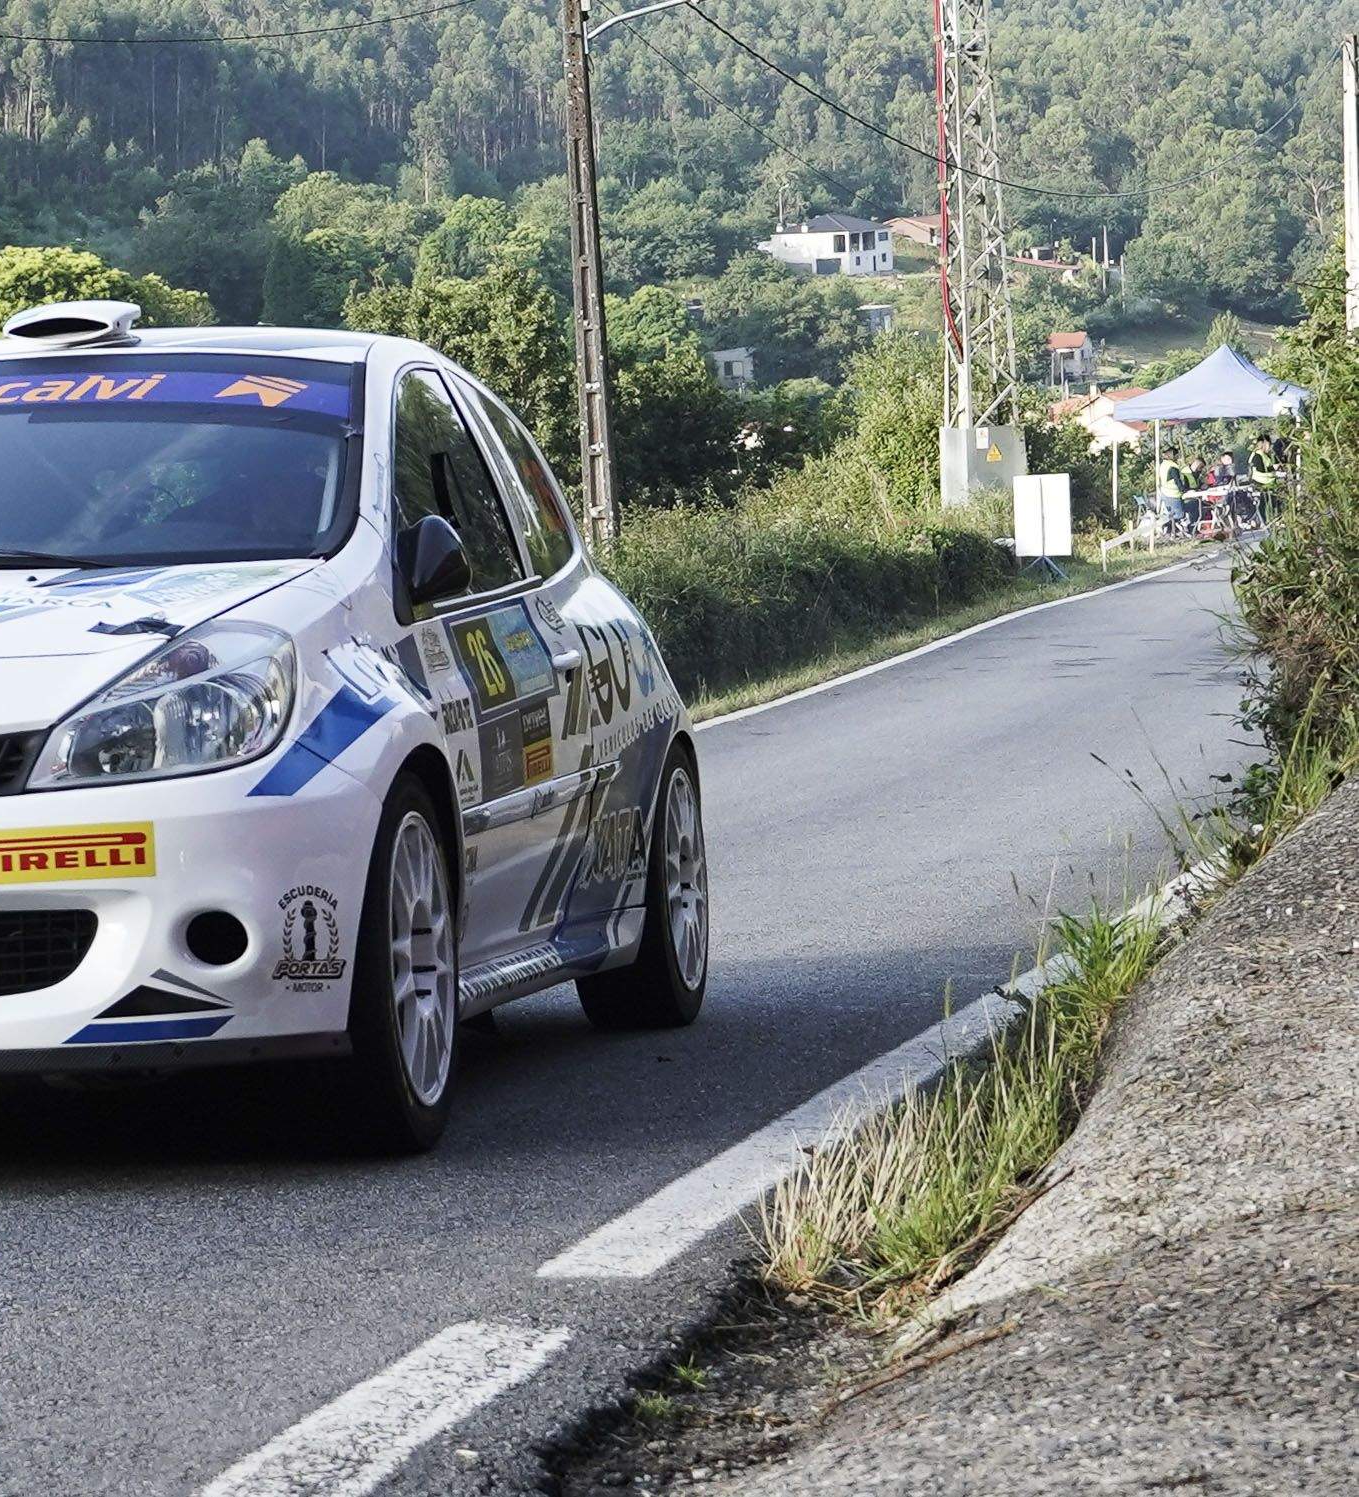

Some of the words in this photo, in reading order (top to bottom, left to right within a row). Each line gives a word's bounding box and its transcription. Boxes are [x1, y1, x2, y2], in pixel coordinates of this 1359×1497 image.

[466, 628, 506, 697] 26
[274, 960, 344, 977] PORTAS
[292, 982, 324, 992] MOTOR
